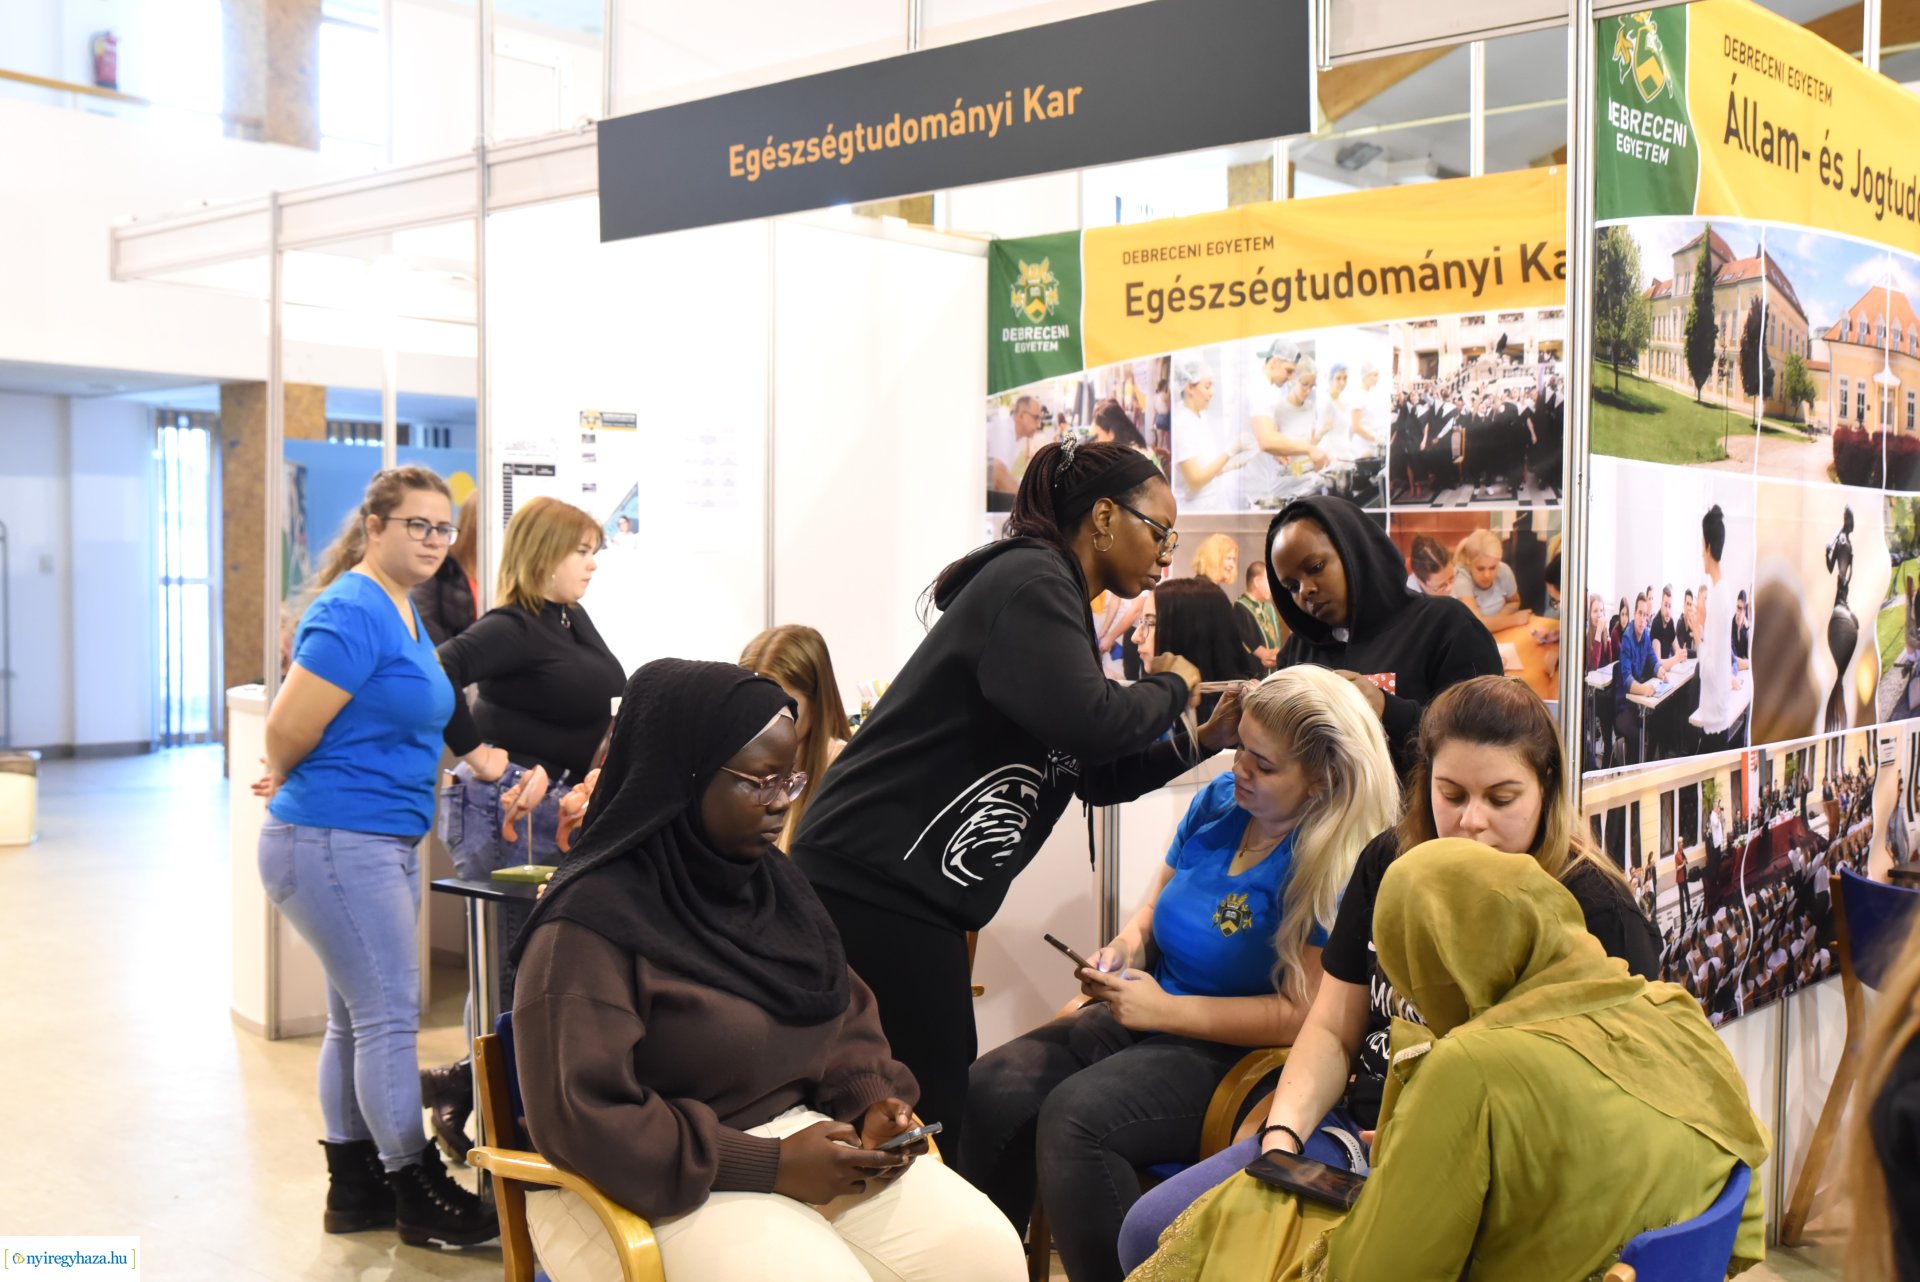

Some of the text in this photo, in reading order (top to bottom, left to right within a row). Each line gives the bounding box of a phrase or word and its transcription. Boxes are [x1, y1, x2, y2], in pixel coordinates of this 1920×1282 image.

[1723, 34, 1833, 108] DEBRECENI EGYETEM
[729, 84, 1083, 181] Egészségtudományi Kar
[1616, 132, 1670, 166] EGYETEM
[1723, 72, 1920, 225] Állam- és Jogtud
[1123, 235, 1275, 265] DEBRECENI EGYETEM
[1125, 245, 1502, 324] Egészségtudományi
[1002, 323, 1069, 342] DEBRECENI
[1014, 340, 1059, 353] EGYETEM
